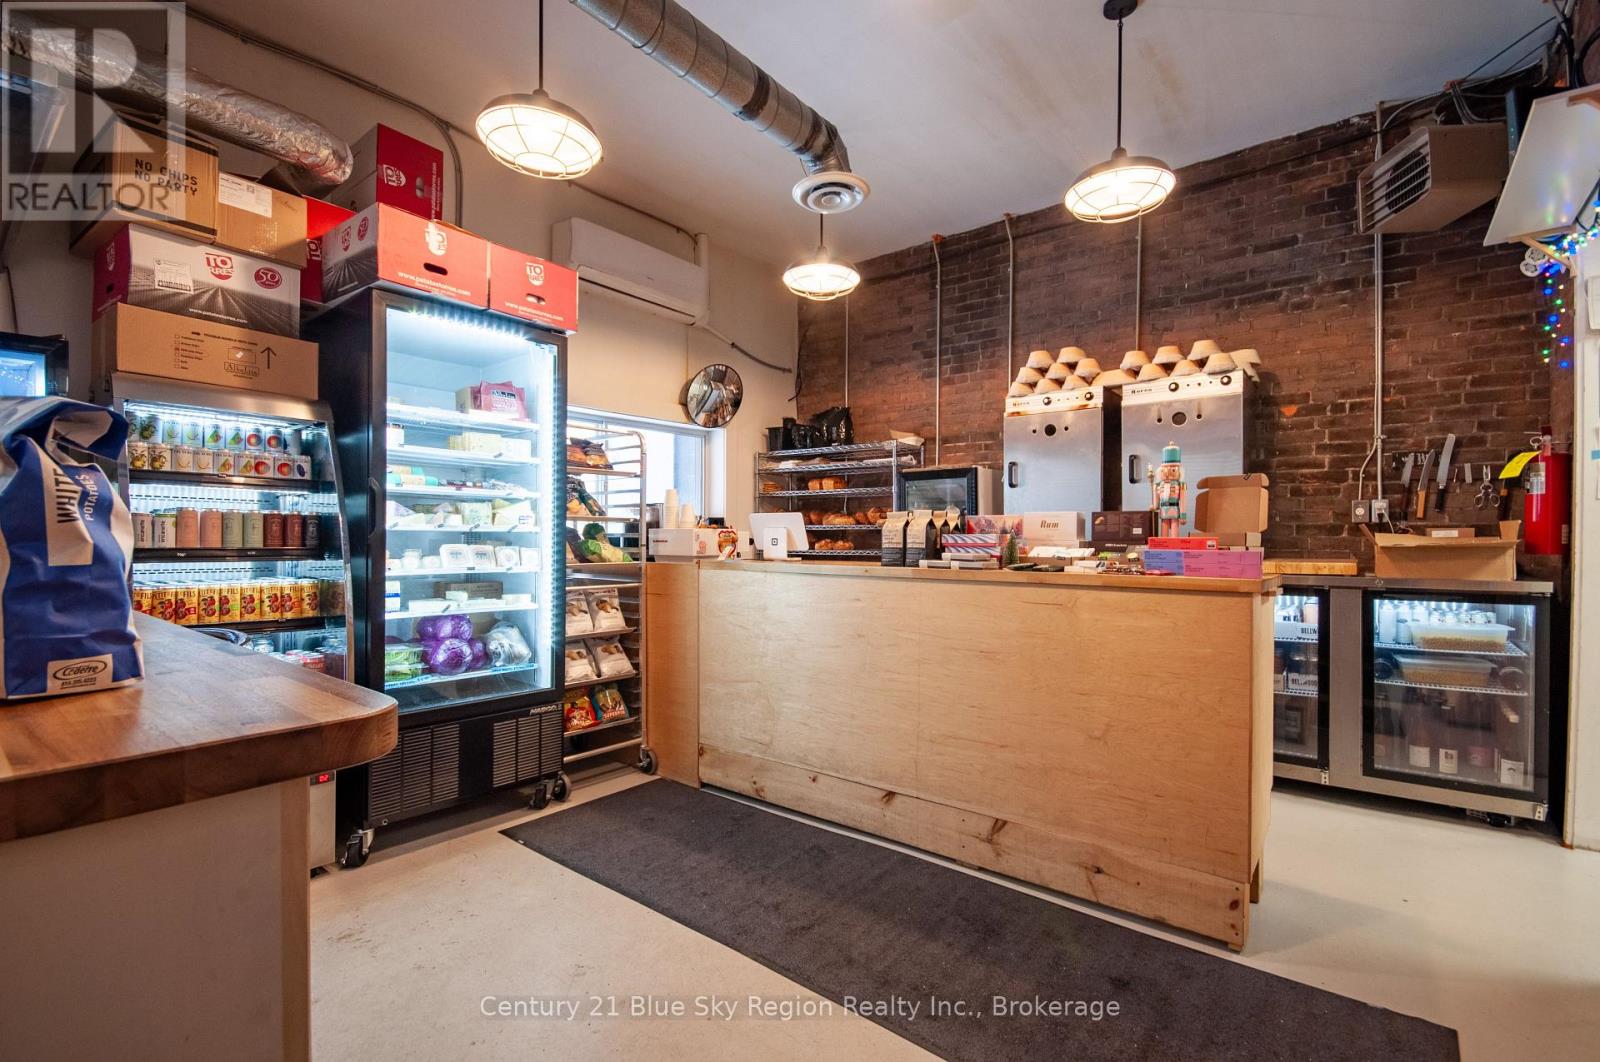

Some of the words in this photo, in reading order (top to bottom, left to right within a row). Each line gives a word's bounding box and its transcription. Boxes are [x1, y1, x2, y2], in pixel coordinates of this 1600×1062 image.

[135, 158, 152, 172] NO
[160, 166, 198, 186] CHIPS
[135, 169, 151, 182] NO
[158, 176, 198, 196] PARTY
